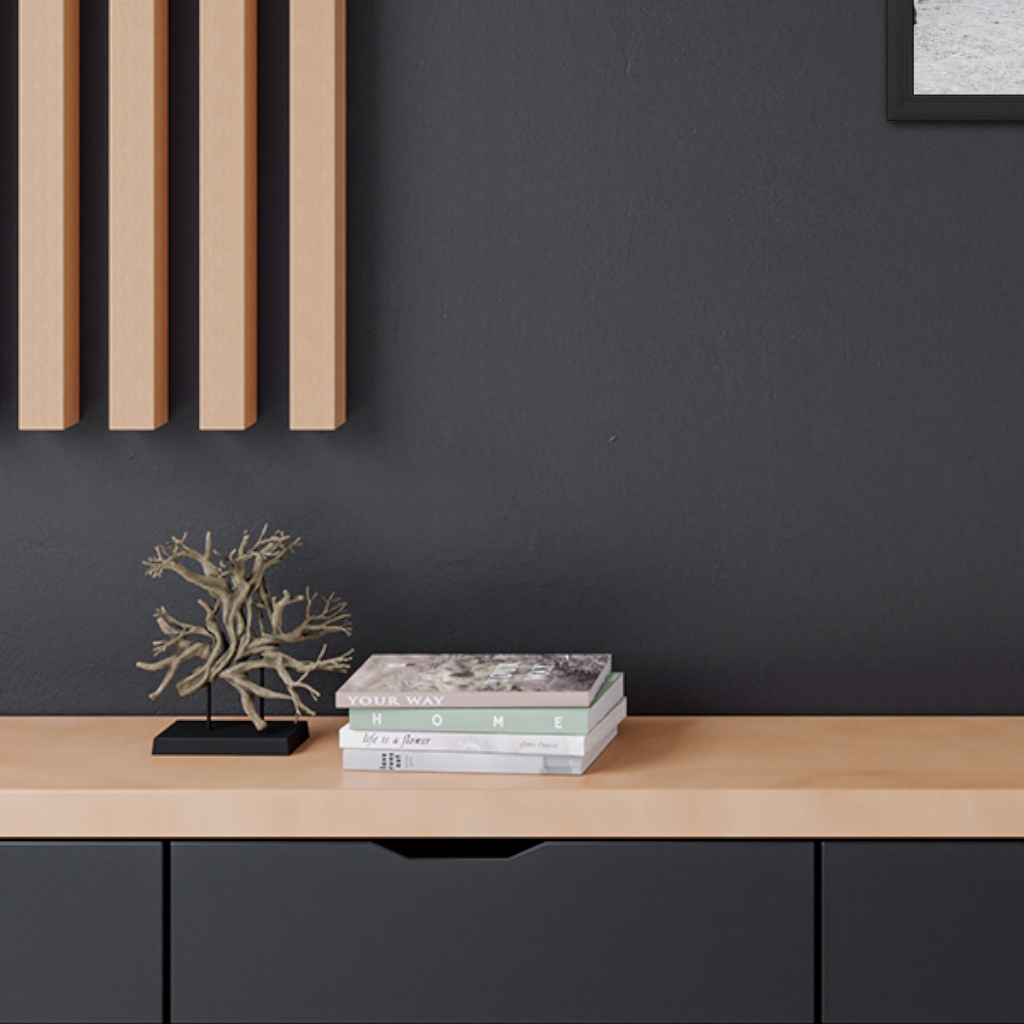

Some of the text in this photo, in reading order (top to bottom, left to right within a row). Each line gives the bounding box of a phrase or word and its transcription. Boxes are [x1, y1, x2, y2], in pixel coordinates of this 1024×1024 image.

[347, 695, 444, 706] YOUR WAY
[362, 732, 378, 748] life
[399, 733, 431, 749] flower
